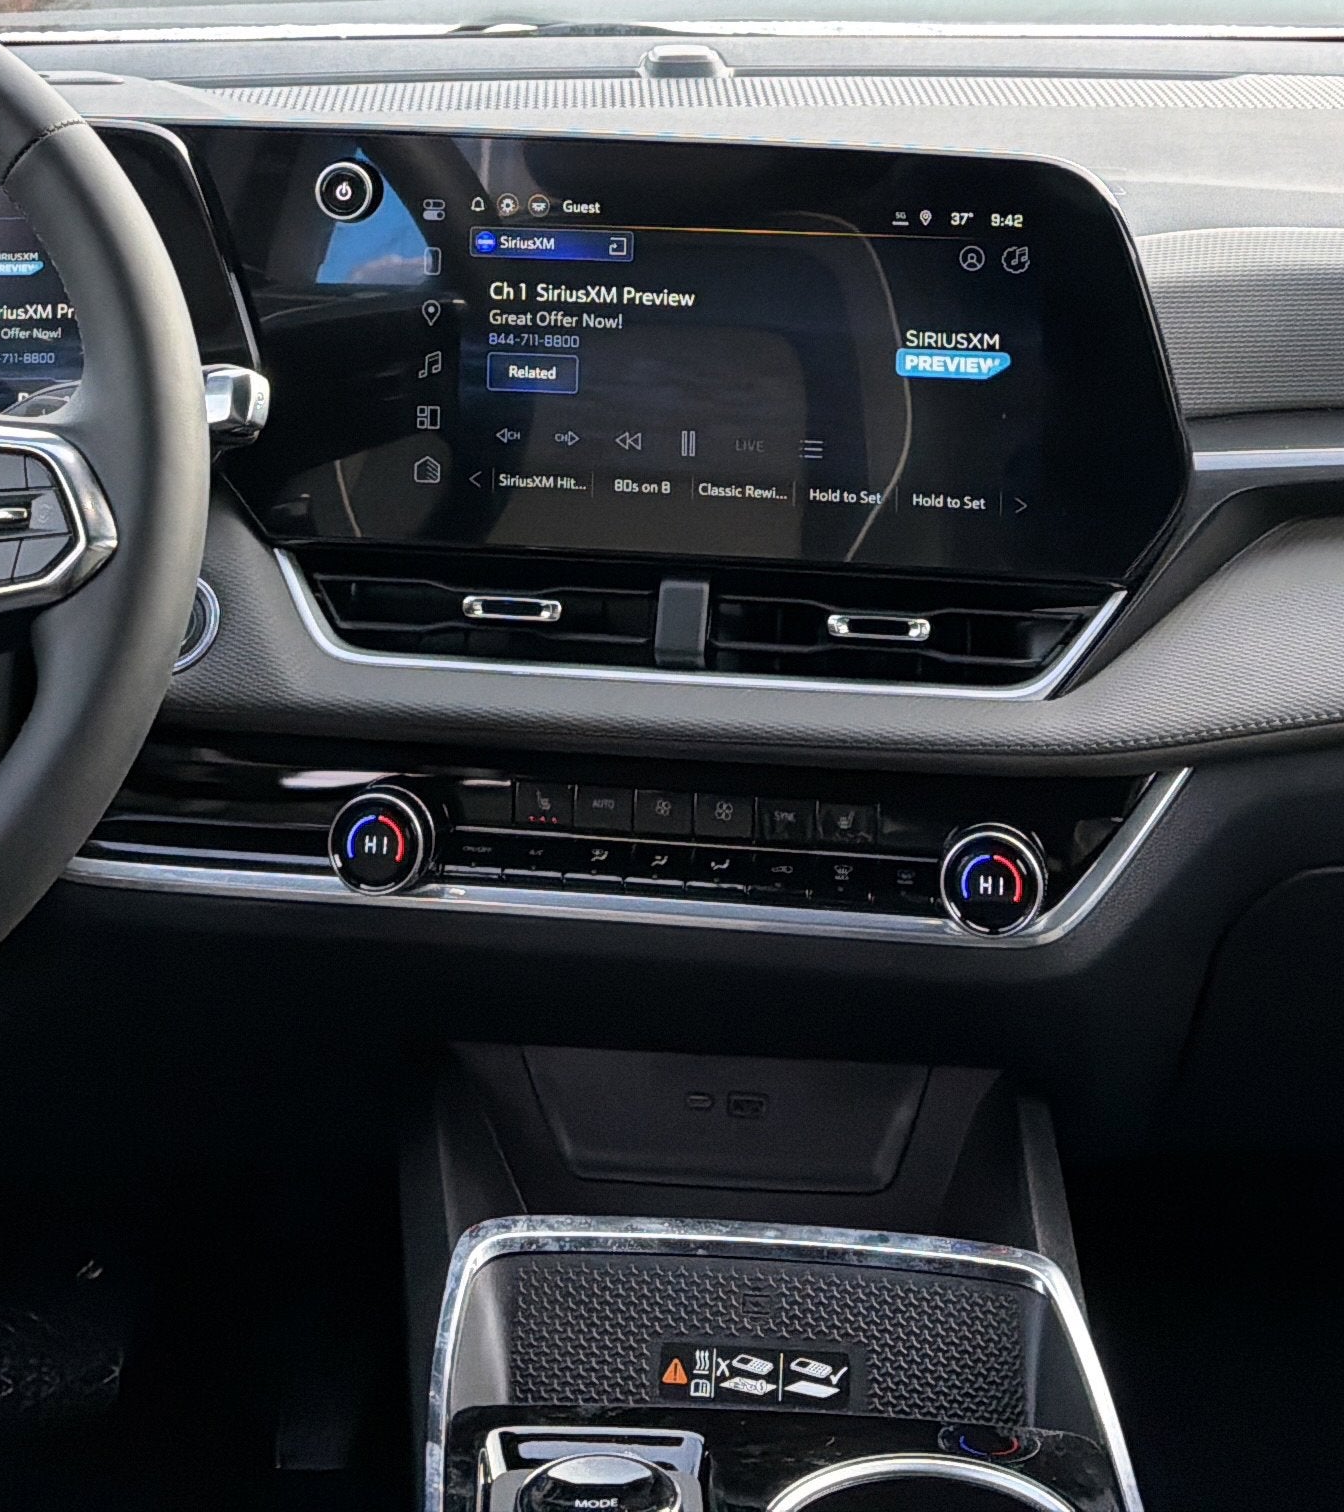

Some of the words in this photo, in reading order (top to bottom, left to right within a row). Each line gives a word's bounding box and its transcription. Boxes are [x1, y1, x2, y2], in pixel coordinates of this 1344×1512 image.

[562, 200, 601, 214] Guest
[950, 212, 974, 226] 37°
[990, 213, 1024, 228] 9:42
[500, 236, 555, 251] SiriusXM
[490, 282, 514, 301] Ch
[520, 283, 527, 300] 1
[536, 284, 617, 304] SiriusXM
[623, 287, 696, 307] Preview
[489, 310, 533, 326] Great
[537, 311, 579, 327] Offer
[582, 313, 623, 329] Now!
[1, 328, 31, 340] Offer
[33, 328, 61, 339] Now!
[488, 333, 580, 348] 844-711-8800
[906, 330, 1000, 350] SIRIUSXM
[905, 355, 1001, 373] PREVIEW
[509, 365, 557, 380] Related
[735, 440, 764, 453] LIVE
[499, 474, 554, 488] SiriusXM
[614, 479, 638, 493] 80s
[641, 482, 658, 493] on
[661, 481, 671, 494] 8
[698, 483, 743, 497] Classic
[810, 488, 840, 503] Hold
[843, 490, 857, 503] to
[860, 490, 882, 504] Set
[913, 493, 944, 508] Hold
[947, 495, 960, 508] to
[963, 496, 986, 510] Set
[592, 798, 615, 809] AUTO
[575, 1498, 619, 1508] MODE
